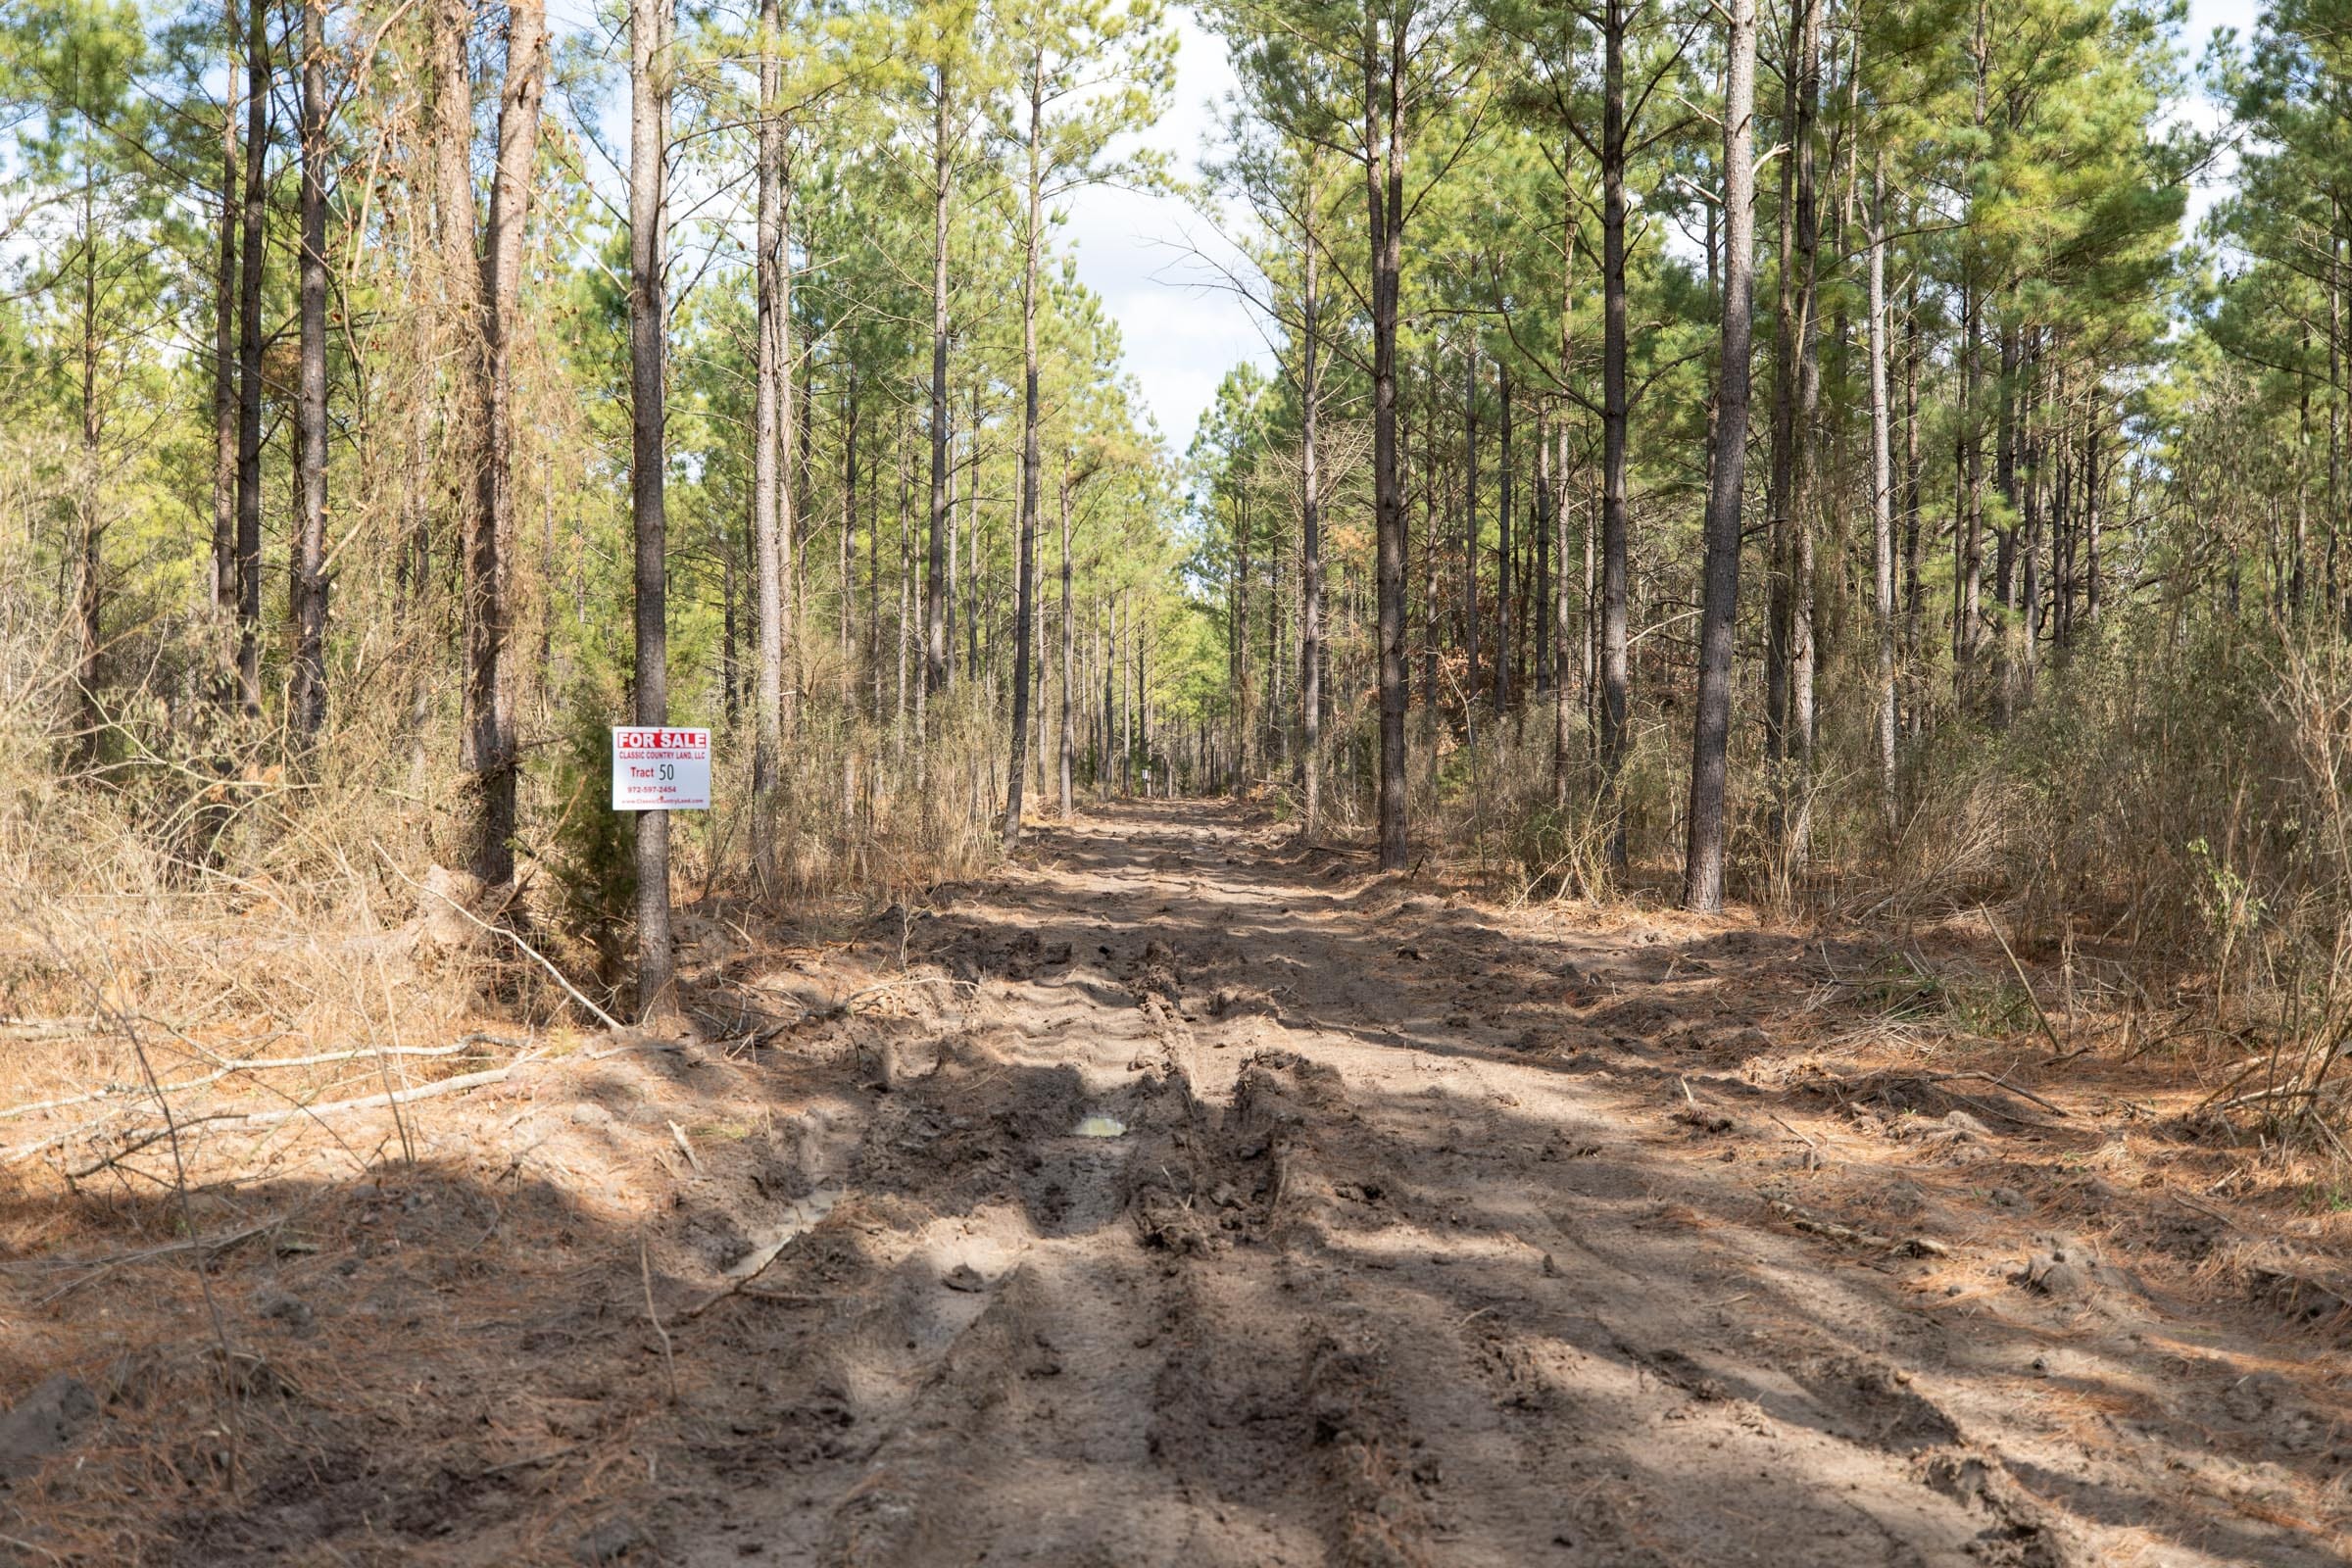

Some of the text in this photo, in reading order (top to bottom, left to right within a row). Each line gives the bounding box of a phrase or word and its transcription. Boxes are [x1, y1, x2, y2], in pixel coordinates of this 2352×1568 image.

[618, 733, 706, 748] FOR SALE
[676, 752, 694, 760] LAND,
[630, 764, 674, 780] Tract 50
